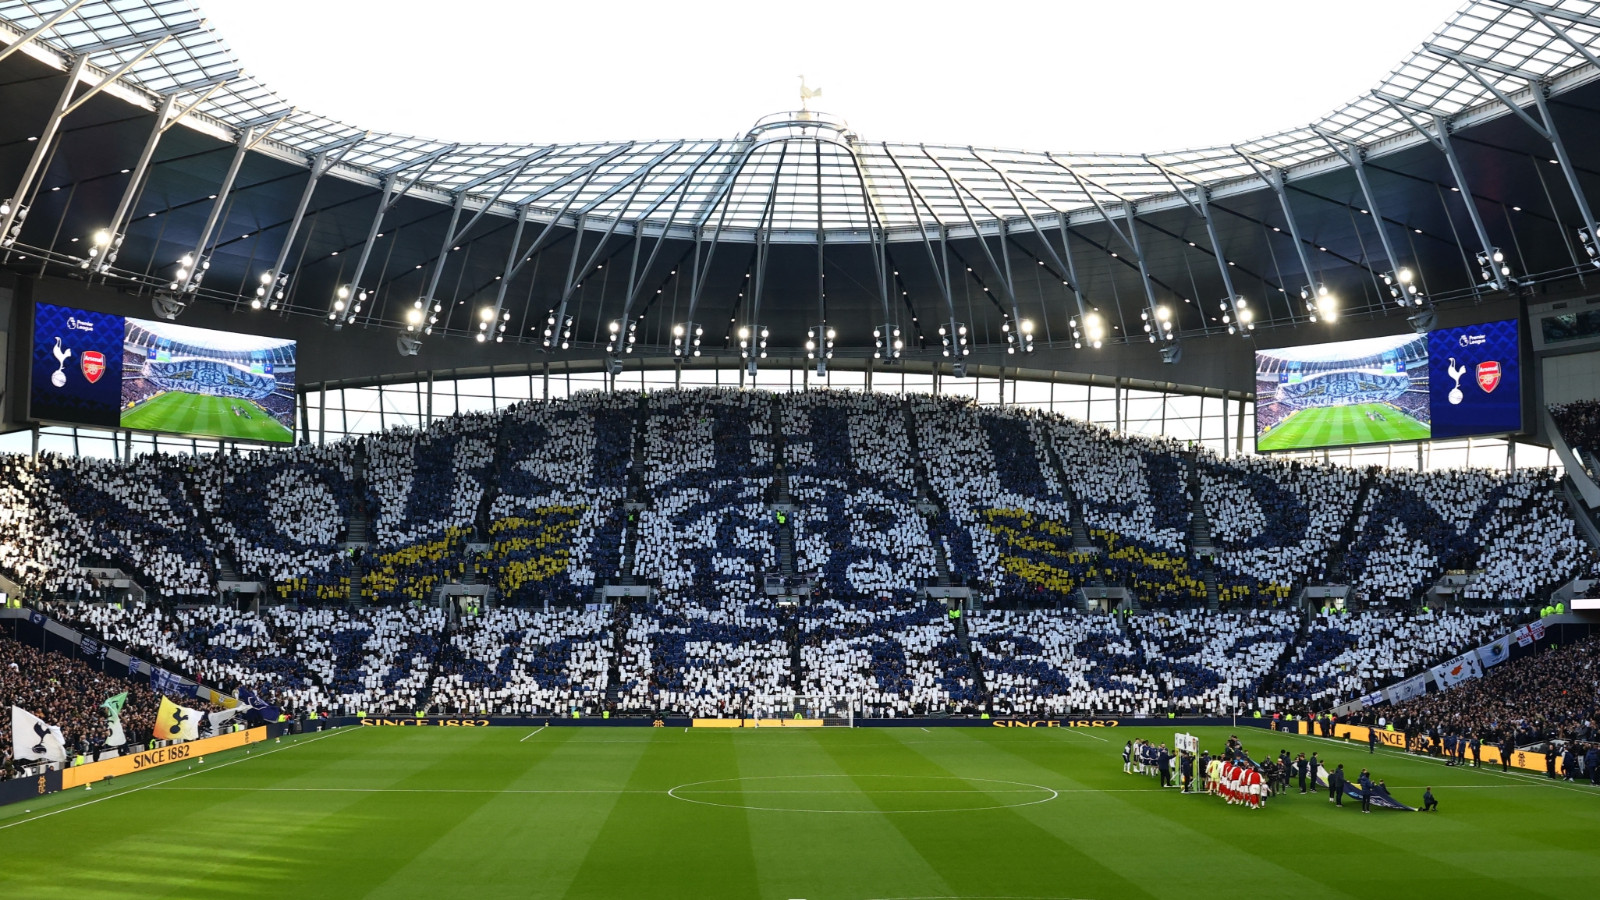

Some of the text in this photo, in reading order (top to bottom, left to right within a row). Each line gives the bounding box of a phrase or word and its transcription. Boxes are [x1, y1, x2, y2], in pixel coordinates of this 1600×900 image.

[84, 355, 103, 363] Arsenal
[1441, 655, 1465, 669] SPURS
[360, 718, 490, 727] SINCE 1882
[992, 720, 1119, 728] SINCE 1882
[133, 744, 190, 769] SINCE 1882
